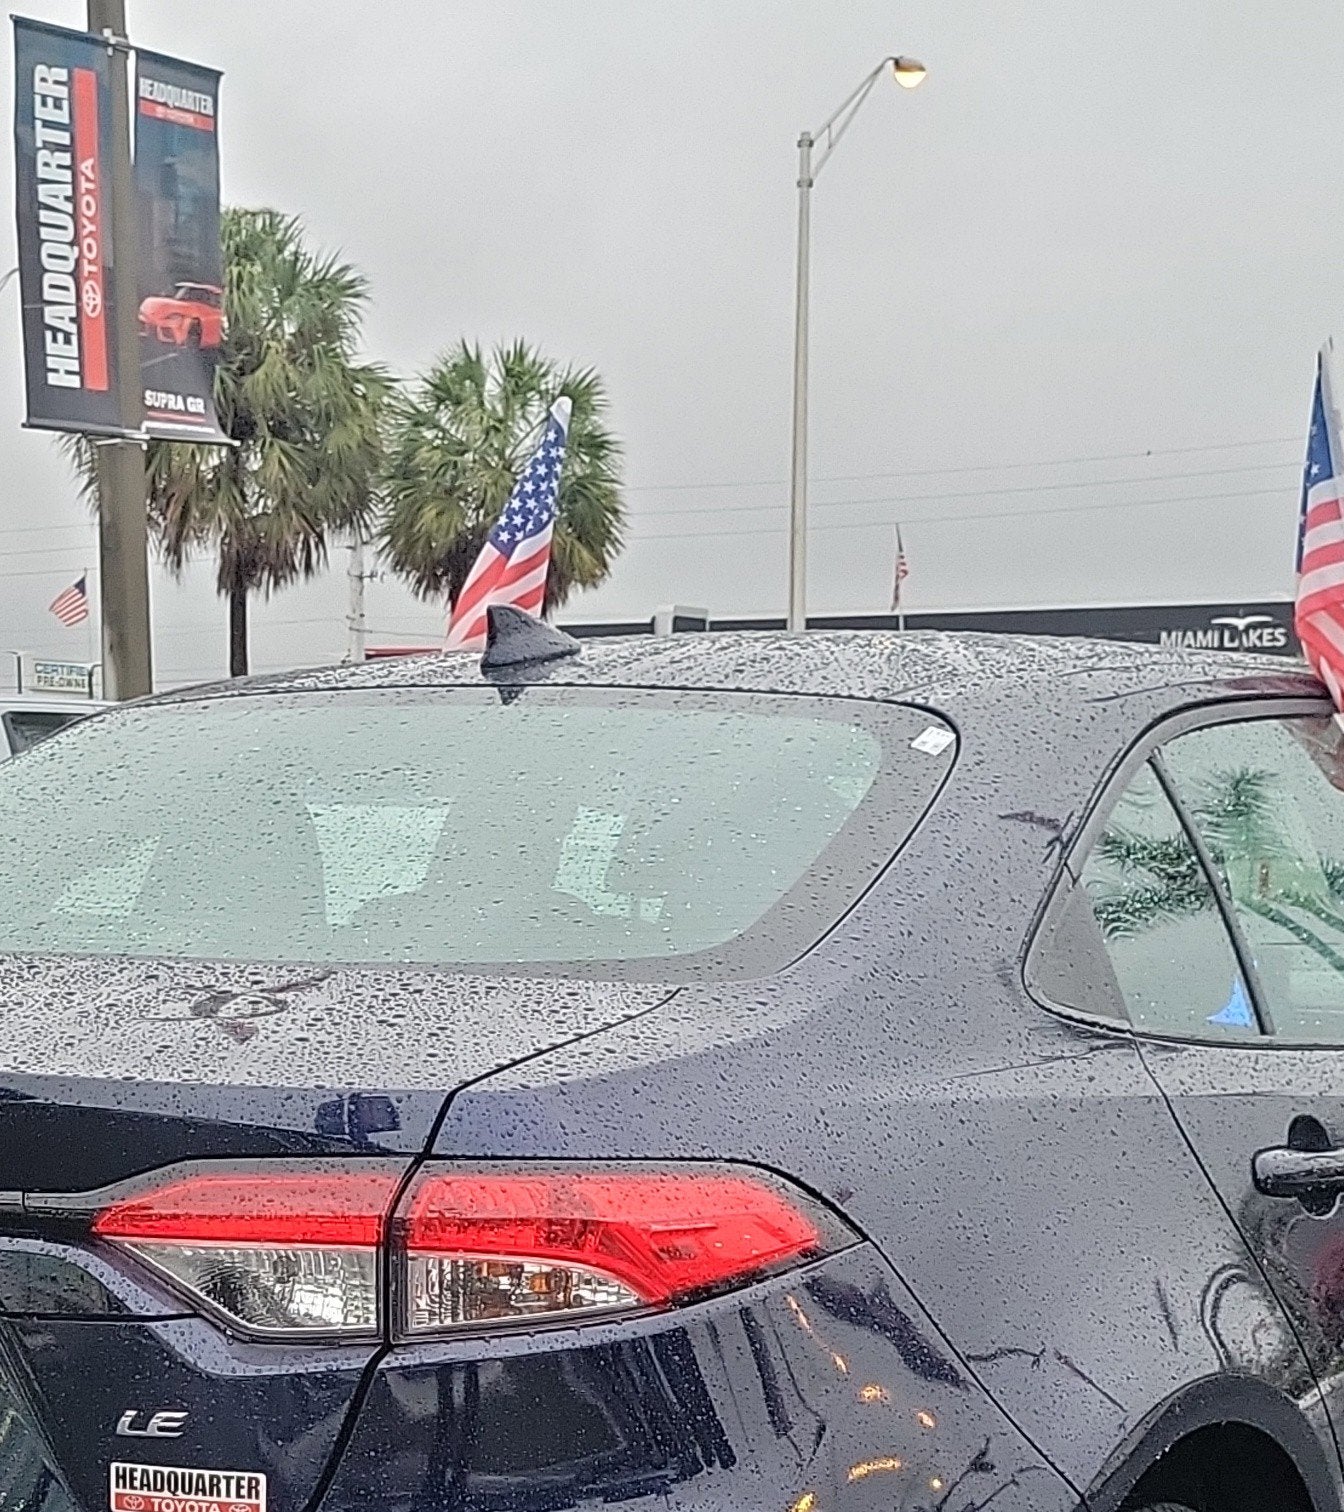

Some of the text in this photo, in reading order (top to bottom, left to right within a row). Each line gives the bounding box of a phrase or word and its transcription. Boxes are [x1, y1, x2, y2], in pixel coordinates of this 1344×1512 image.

[139, 77, 214, 116] HEADQUARTER
[34, 64, 82, 388] HEADQUARTER
[79, 158, 102, 277] TOYOTA
[144, 389, 205, 414] SUPRA GR
[1159, 628, 1287, 648] MIAMI LAKES
[35, 663, 87, 676] CERTIFIE
[37, 675, 86, 688] PRE-OWNE
[116, 1410, 189, 1438] LE
[115, 1465, 261, 1500] HEADQUARTER
